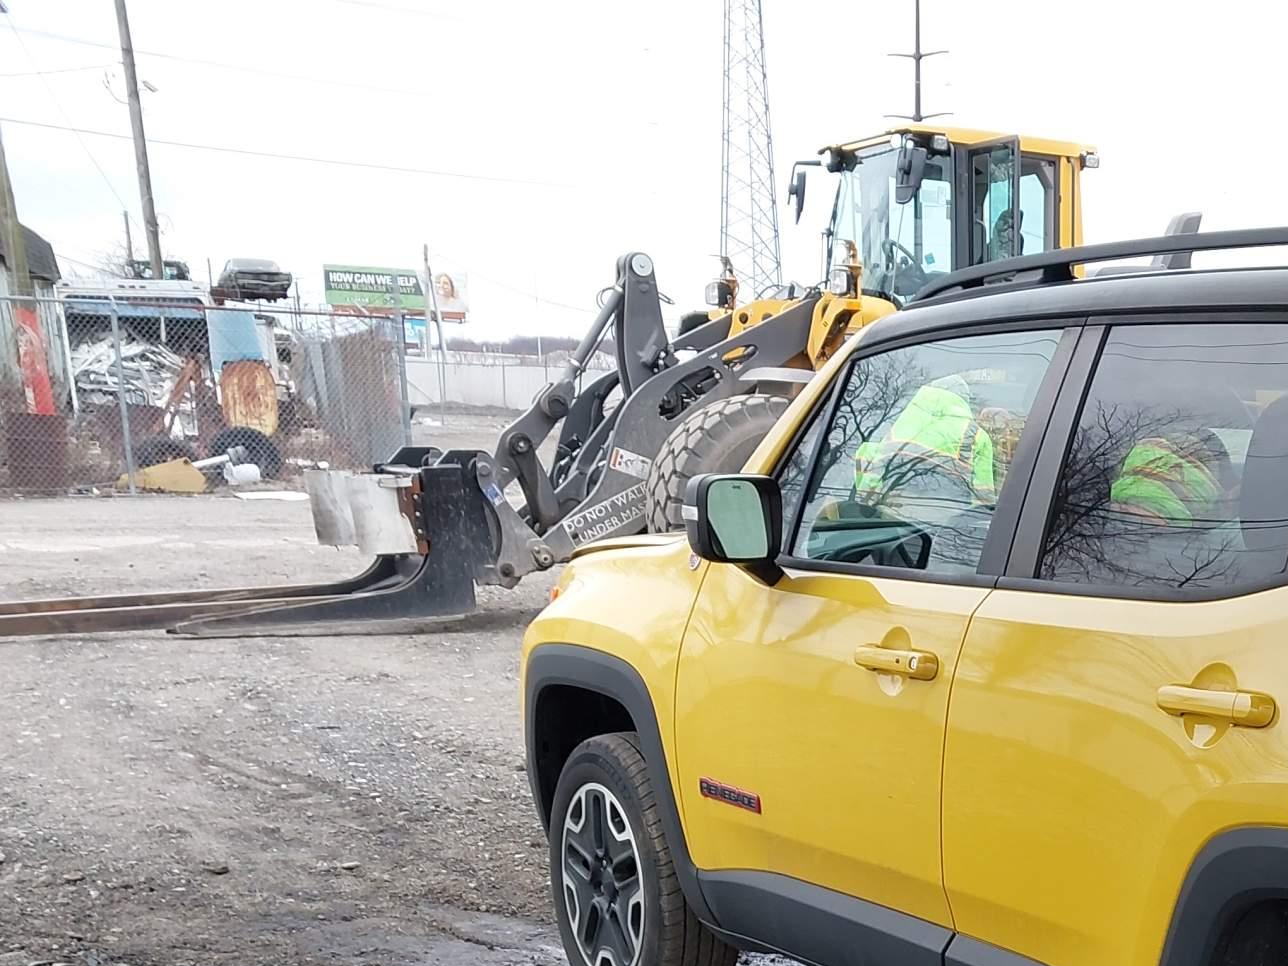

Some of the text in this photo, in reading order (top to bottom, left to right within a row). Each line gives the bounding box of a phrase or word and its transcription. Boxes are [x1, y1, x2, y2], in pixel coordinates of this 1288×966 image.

[329, 272, 353, 283] HOW
[354, 273, 375, 285] CAN
[375, 274, 393, 285] WE
[564, 517, 584, 532] DO
[586, 502, 612, 521] NOT
[578, 500, 647, 542] UNDER MAS
